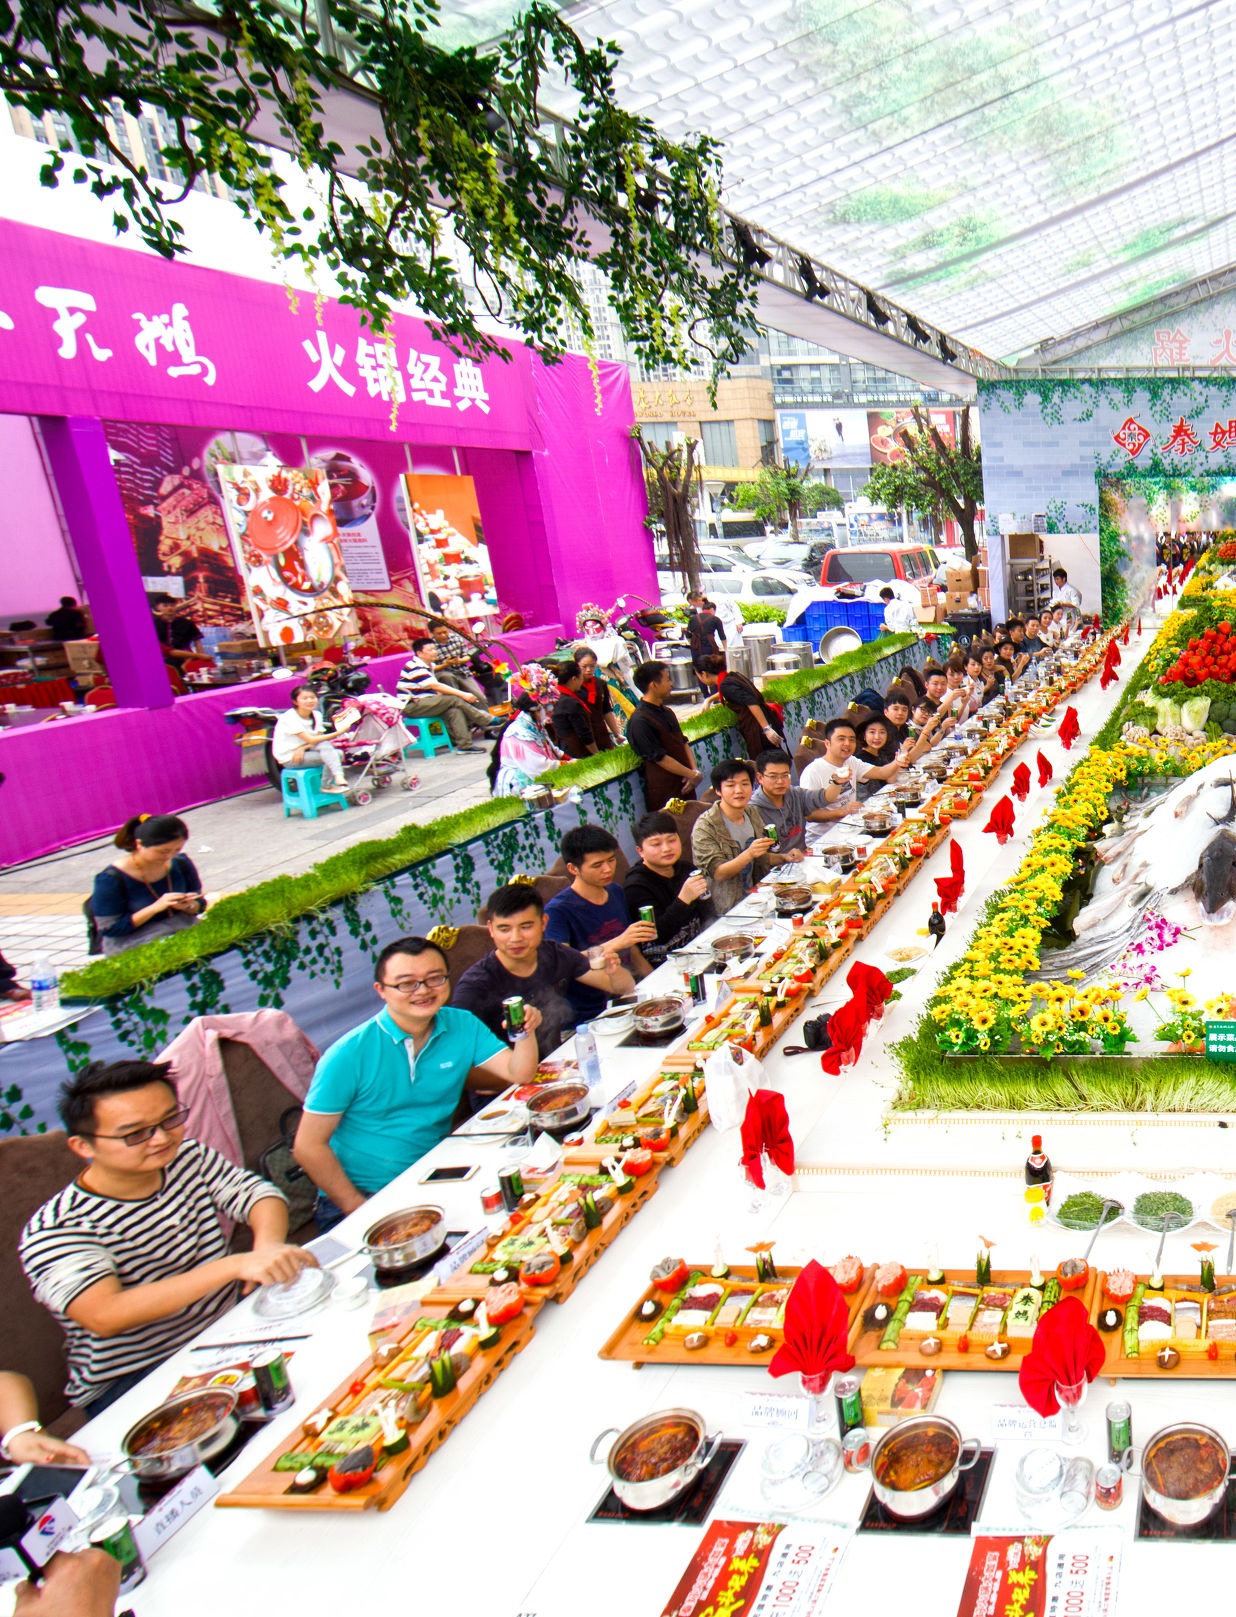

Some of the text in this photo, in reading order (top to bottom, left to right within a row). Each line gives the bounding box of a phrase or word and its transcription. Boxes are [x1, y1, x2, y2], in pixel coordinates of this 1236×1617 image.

[301, 330, 492, 414] 火锅经典
[773, 1580, 800, 1609] 1000
[791, 1544, 816, 1566] 500
[1069, 1554, 1090, 1576] 500
